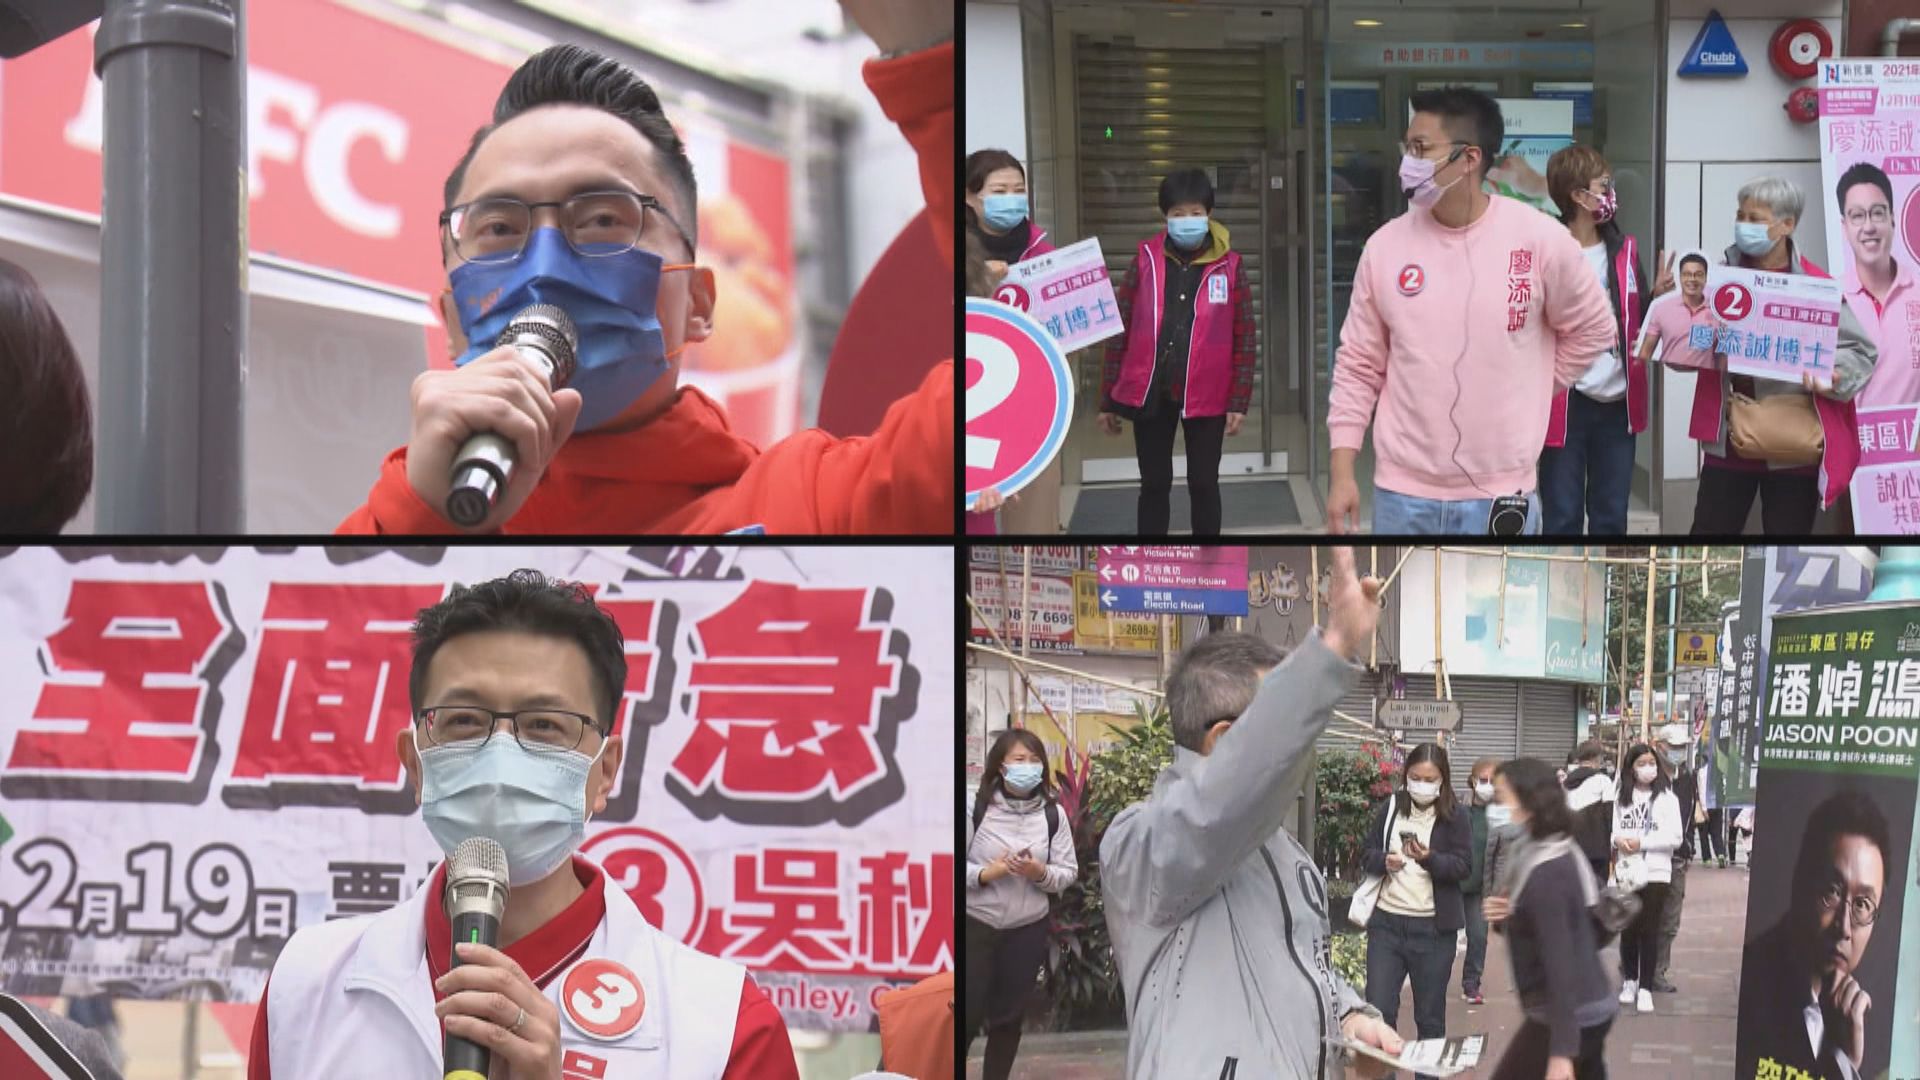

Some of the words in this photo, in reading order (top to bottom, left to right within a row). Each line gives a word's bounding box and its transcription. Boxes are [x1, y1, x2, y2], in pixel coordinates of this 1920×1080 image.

[1383, 47, 1470, 63] 自助銀行服務
[1700, 51, 1736, 62] Chubb
[1829, 119, 1920, 153] 廖添誠
[1405, 268, 1419, 288] 2
[1508, 248, 1532, 332] 廖添誠
[1723, 287, 1743, 315] 2
[1688, 324, 1833, 369] 廖添誠博士
[1143, 549, 1175, 559] Victoria
[1176, 550, 1195, 559] Park
[1144, 575, 1157, 583] Tin
[1158, 576, 1174, 584] Hau
[1176, 576, 1197, 585] Food
[1198, 577, 1227, 587] Square
[1143, 599, 1178, 609] Electric
[1180, 600, 1205, 610] Road
[1769, 658, 1920, 719] 潘焯鴻
[1391, 703, 1407, 712] Lau
[1423, 703, 1450, 713] Street
[1764, 724, 1834, 744] JASON
[1840, 726, 1919, 748] POON
[0, 837, 298, 938] 2月19日
[327, 862, 432, 921] 票
[571, 972, 638, 1025] 3
